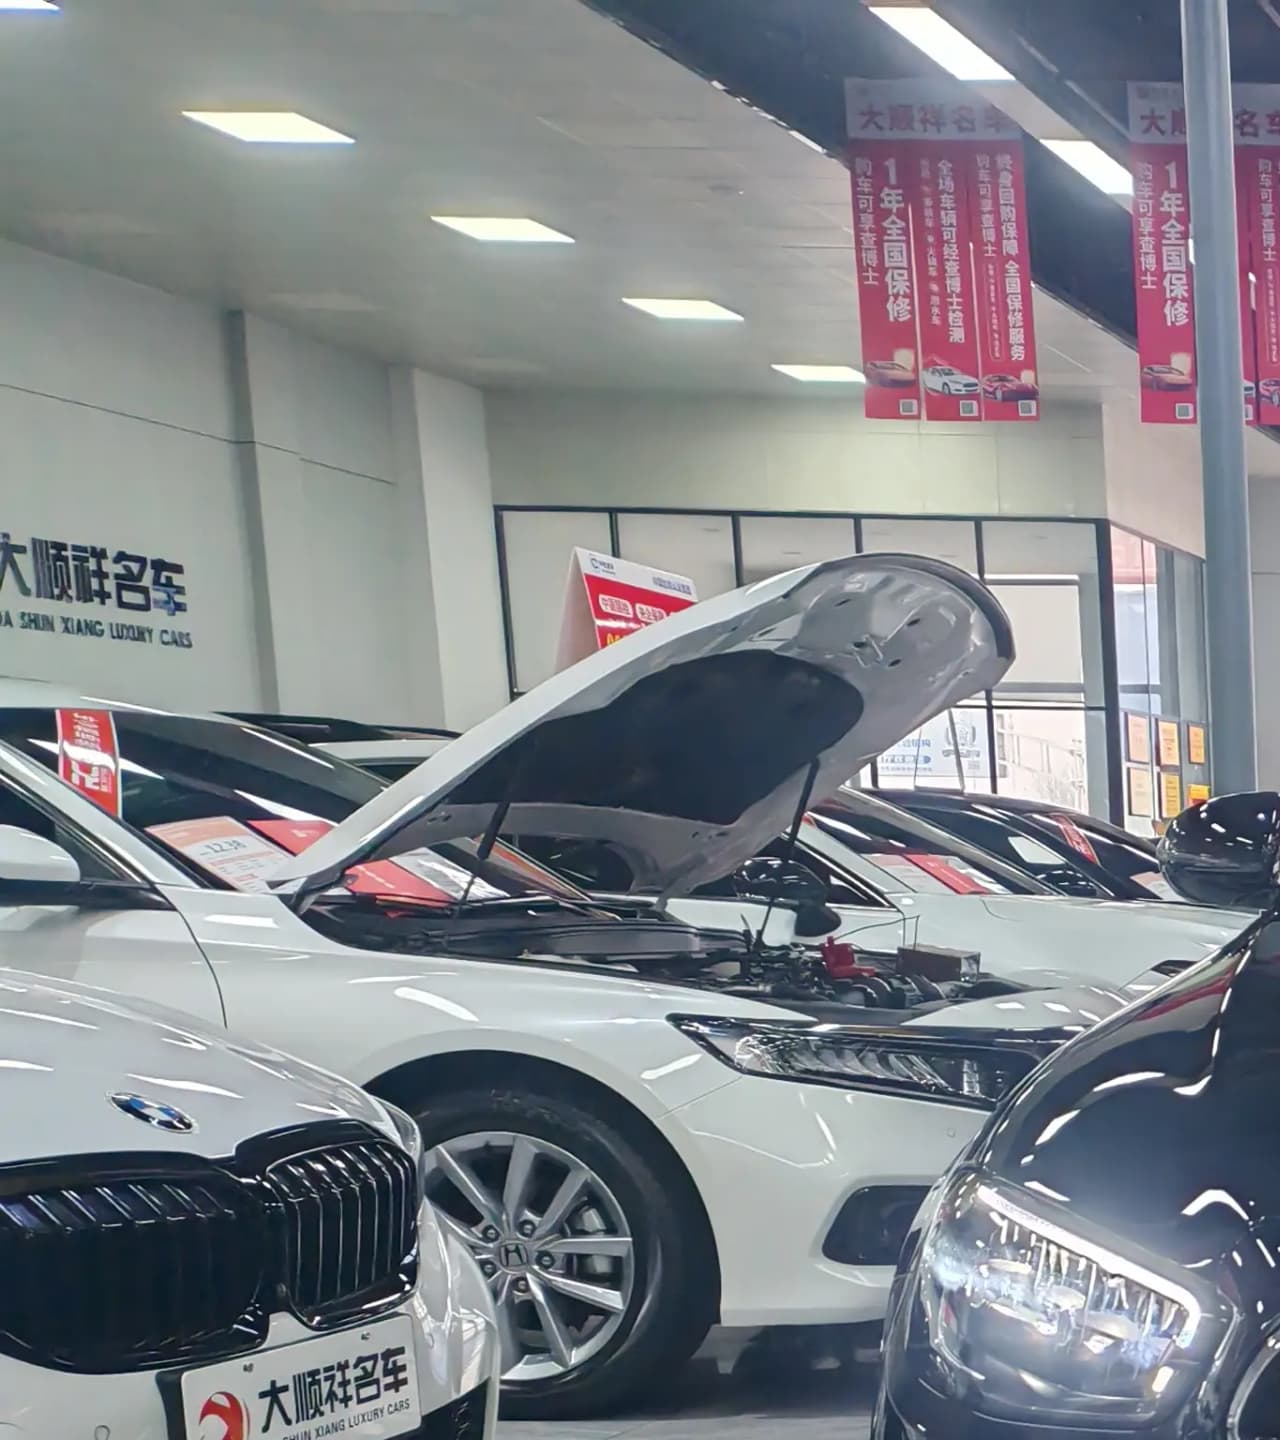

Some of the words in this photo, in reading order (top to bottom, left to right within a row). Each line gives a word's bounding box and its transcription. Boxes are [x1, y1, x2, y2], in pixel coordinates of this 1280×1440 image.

[880, 158, 912, 323] 1年全国保修
[1159, 161, 1189, 327] 1年全国保修
[0, 532, 187, 616] 大顺祥名车
[61, 616, 104, 638] XIANG
[160, 630, 193, 649] CARS
[258, 1346, 408, 1433] 大顺祥名车
[315, 1418, 345, 1440] XIANG
[348, 1406, 385, 1428] LUXURY
[387, 1397, 410, 1415] CARS
